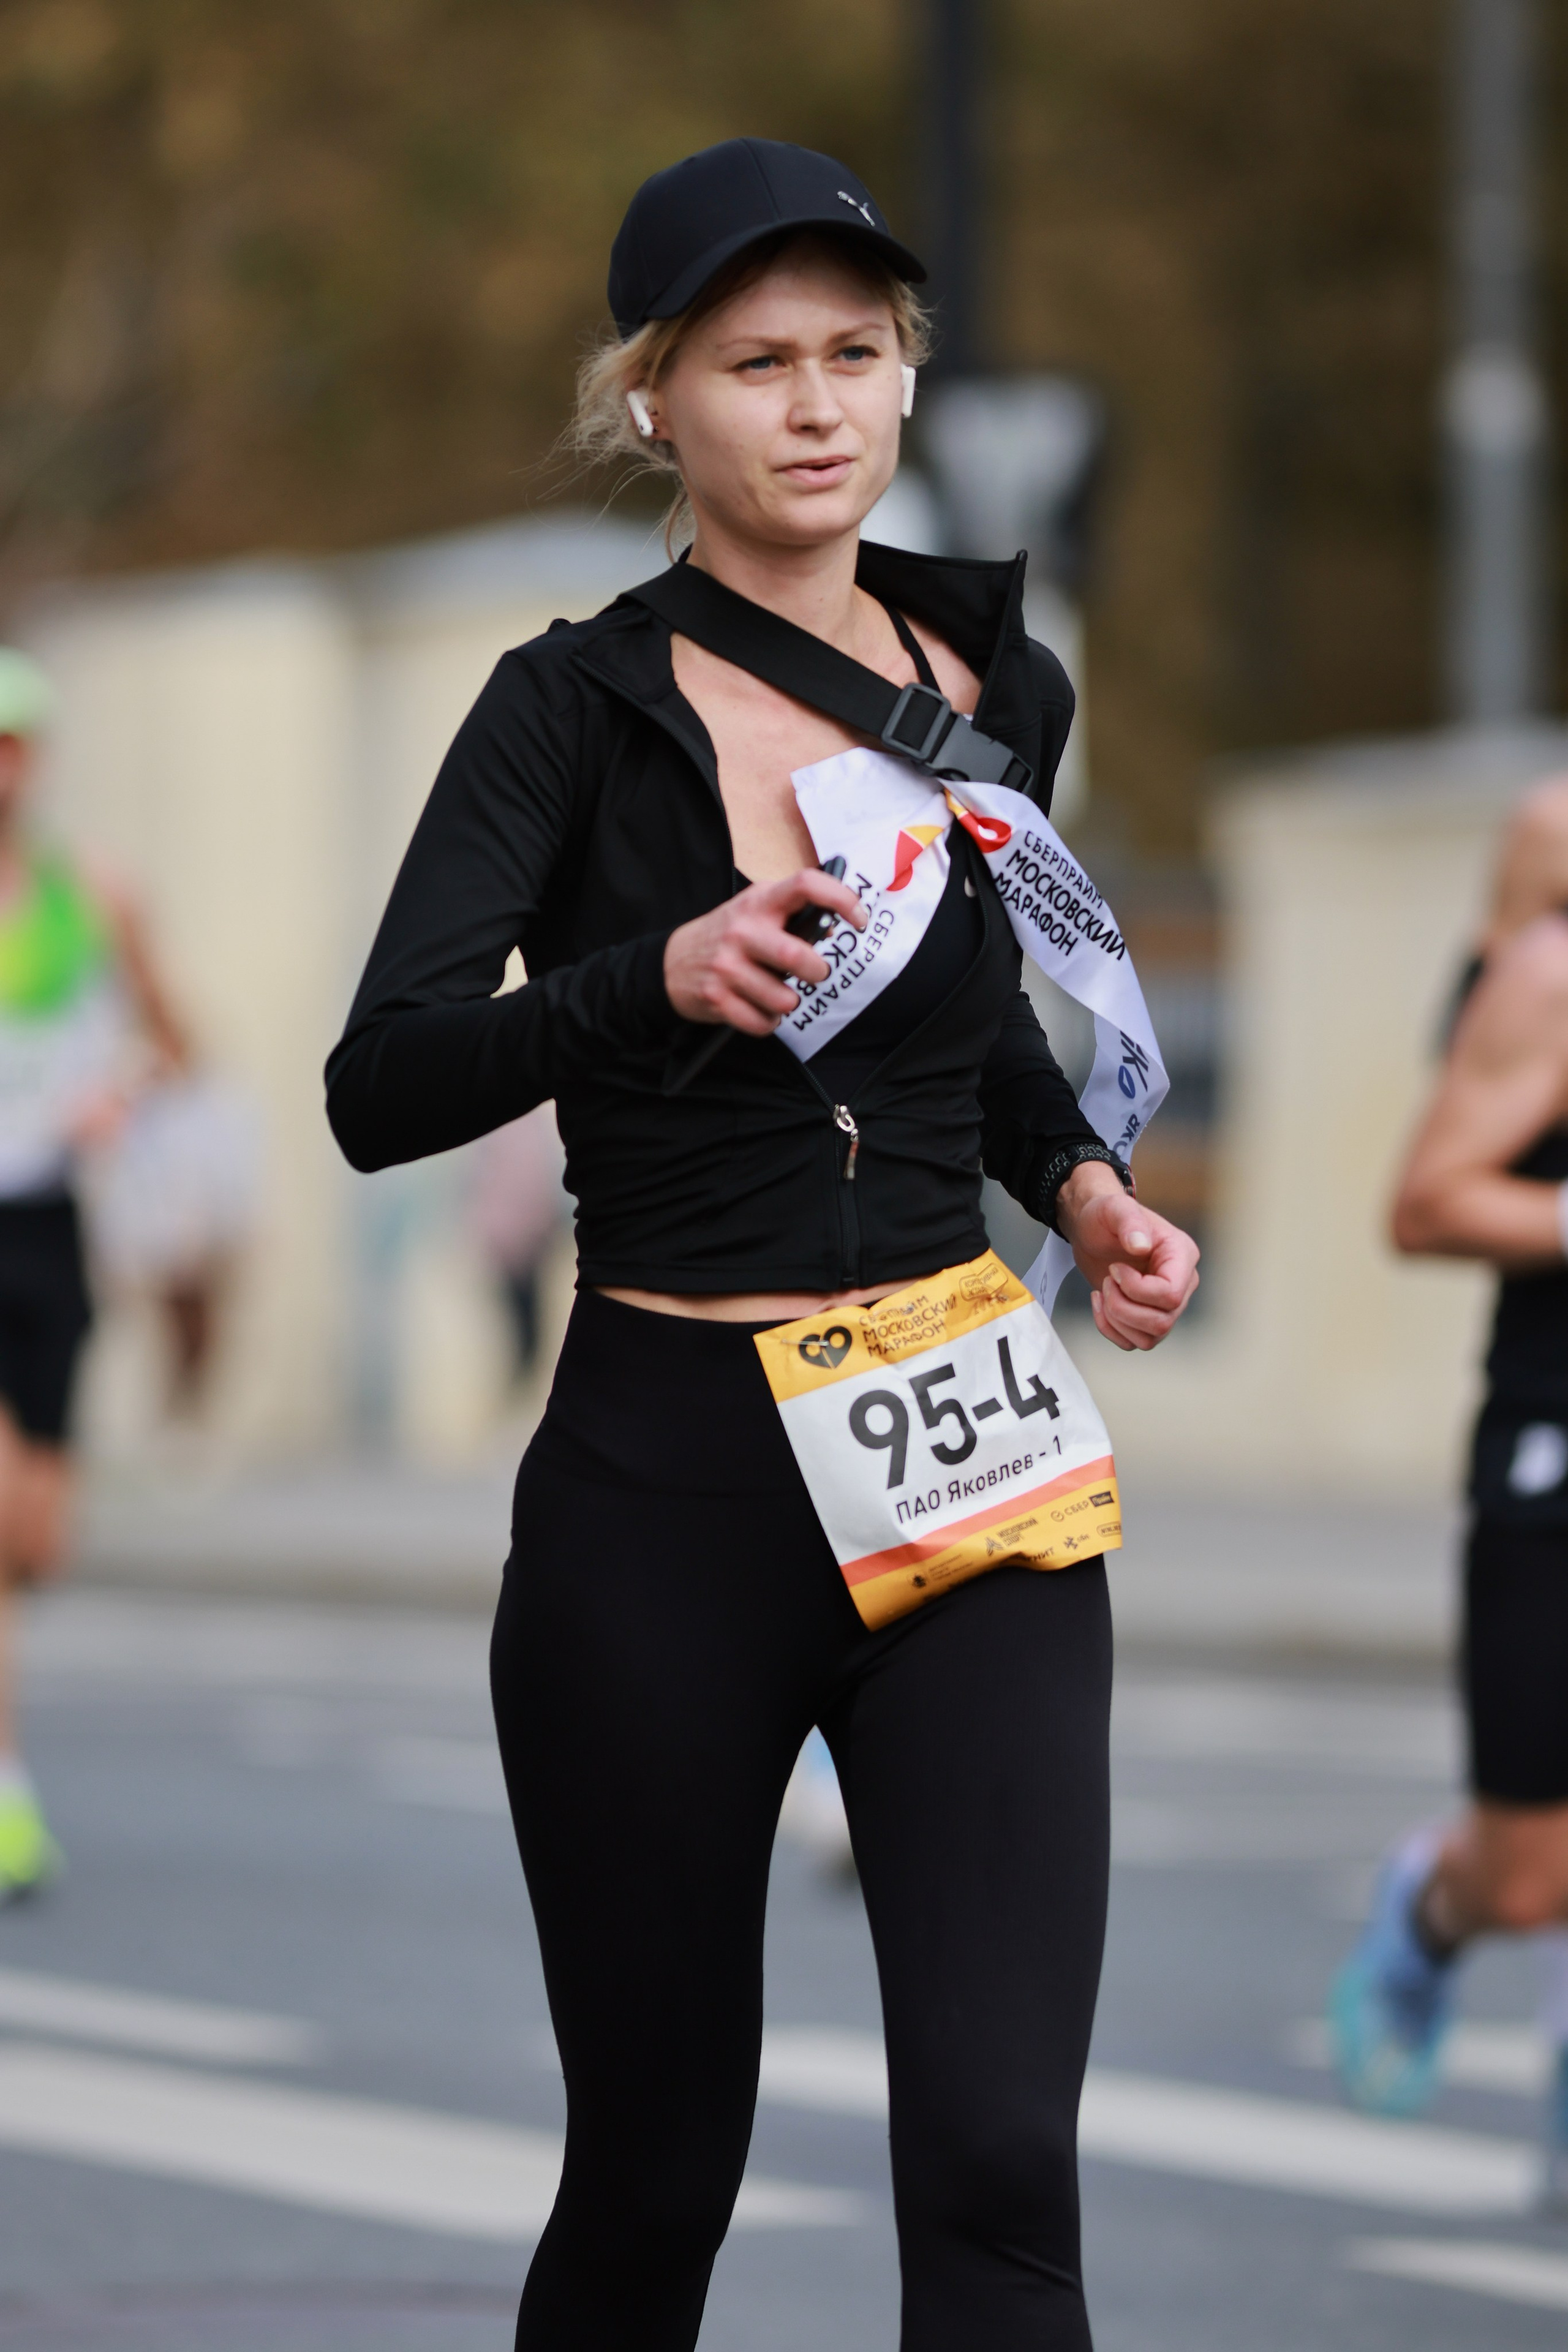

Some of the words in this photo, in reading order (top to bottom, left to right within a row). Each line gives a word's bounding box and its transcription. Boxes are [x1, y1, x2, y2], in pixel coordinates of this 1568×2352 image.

[1006, 849, 1126, 960] МОСКОВСКИЙ
[1024, 831, 1103, 909] СБЕРПРАЙМ
[993, 872, 1078, 956] МАРАФОН
[793, 910, 894, 1031] СБЕРПРАЙМ
[862, 1293, 957, 1343] МОСКОВСКИЙ
[867, 1319, 946, 1357] МАРАФОН
[849, 1335, 1060, 1490] 95-4
[897, 1489, 940, 1524] ПАО
[948, 1453, 1033, 1503] Яковлев
[1052, 1434, 1062, 1456] 1
